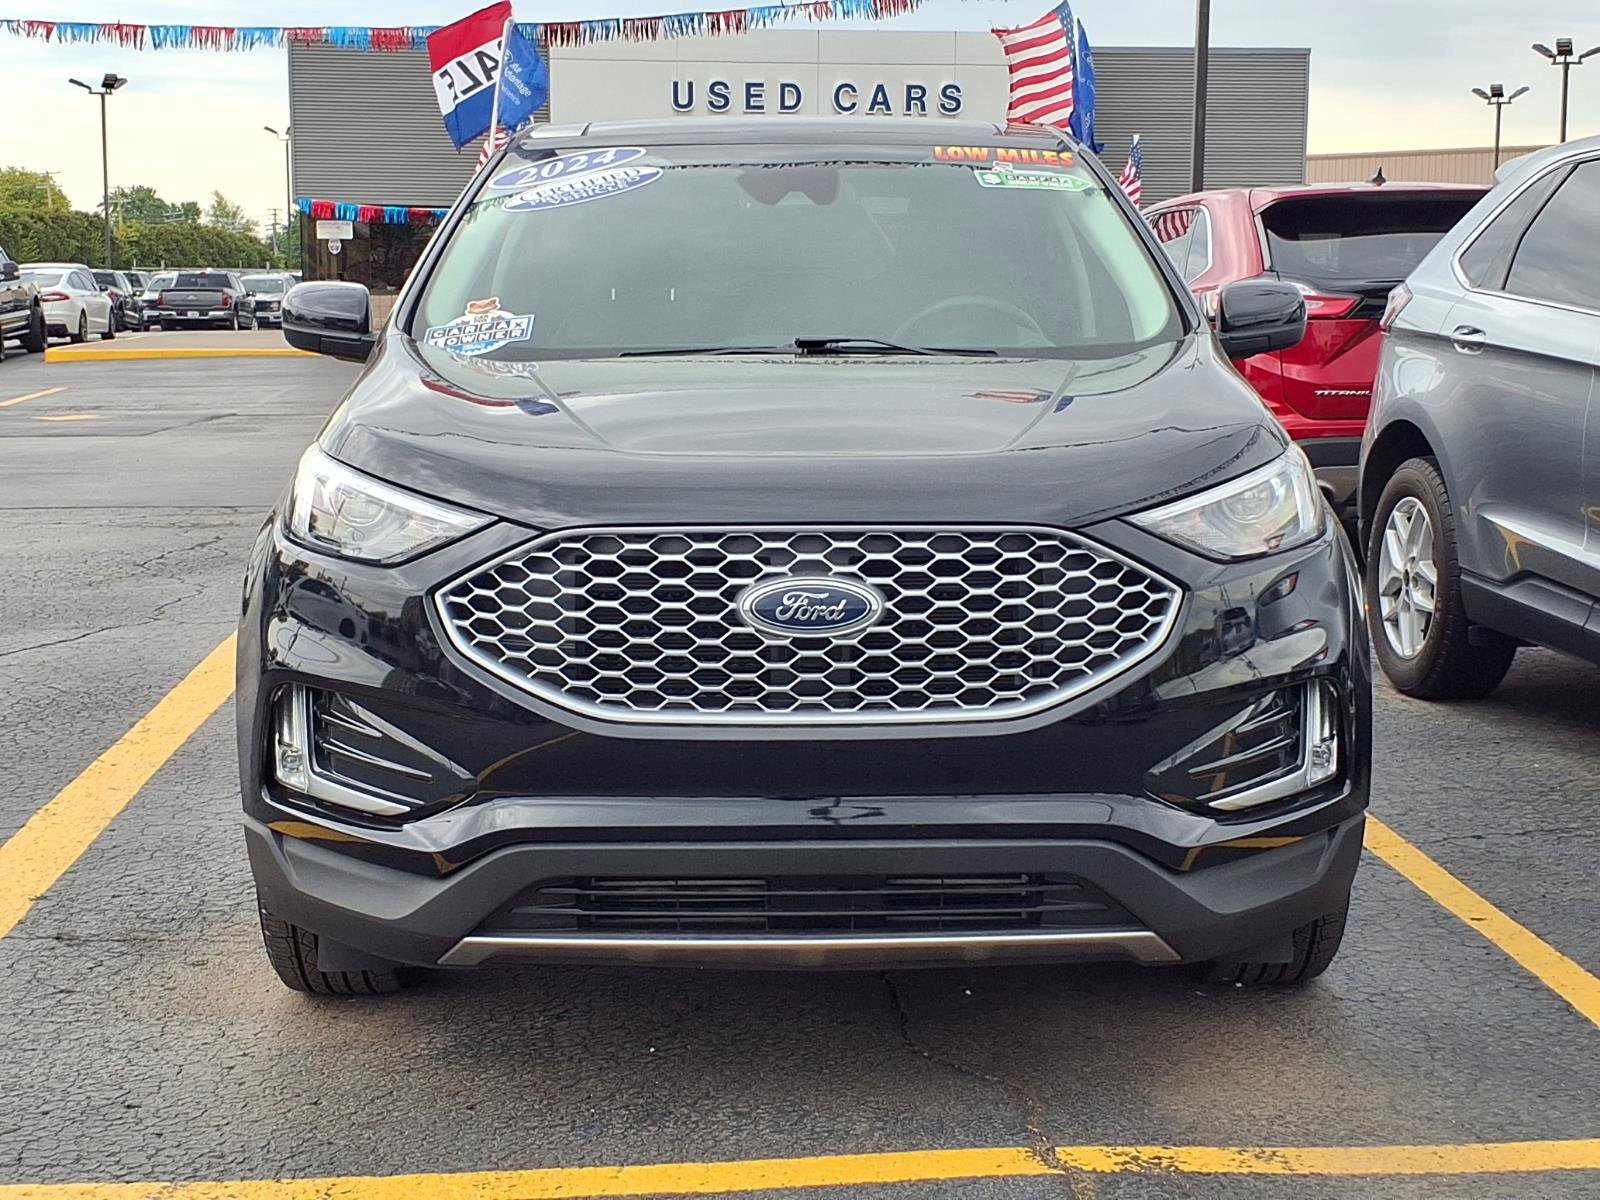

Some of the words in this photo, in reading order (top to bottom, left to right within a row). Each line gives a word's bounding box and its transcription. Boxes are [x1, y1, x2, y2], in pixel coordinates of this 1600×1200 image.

[672, 80, 802, 113] USED
[832, 82, 964, 115] CARS
[515, 150, 617, 185] 2024
[934, 145, 988, 162] LOW
[997, 147, 1074, 167] MILES
[433, 321, 523, 338] CARFAX
[775, 591, 847, 621] Ford
